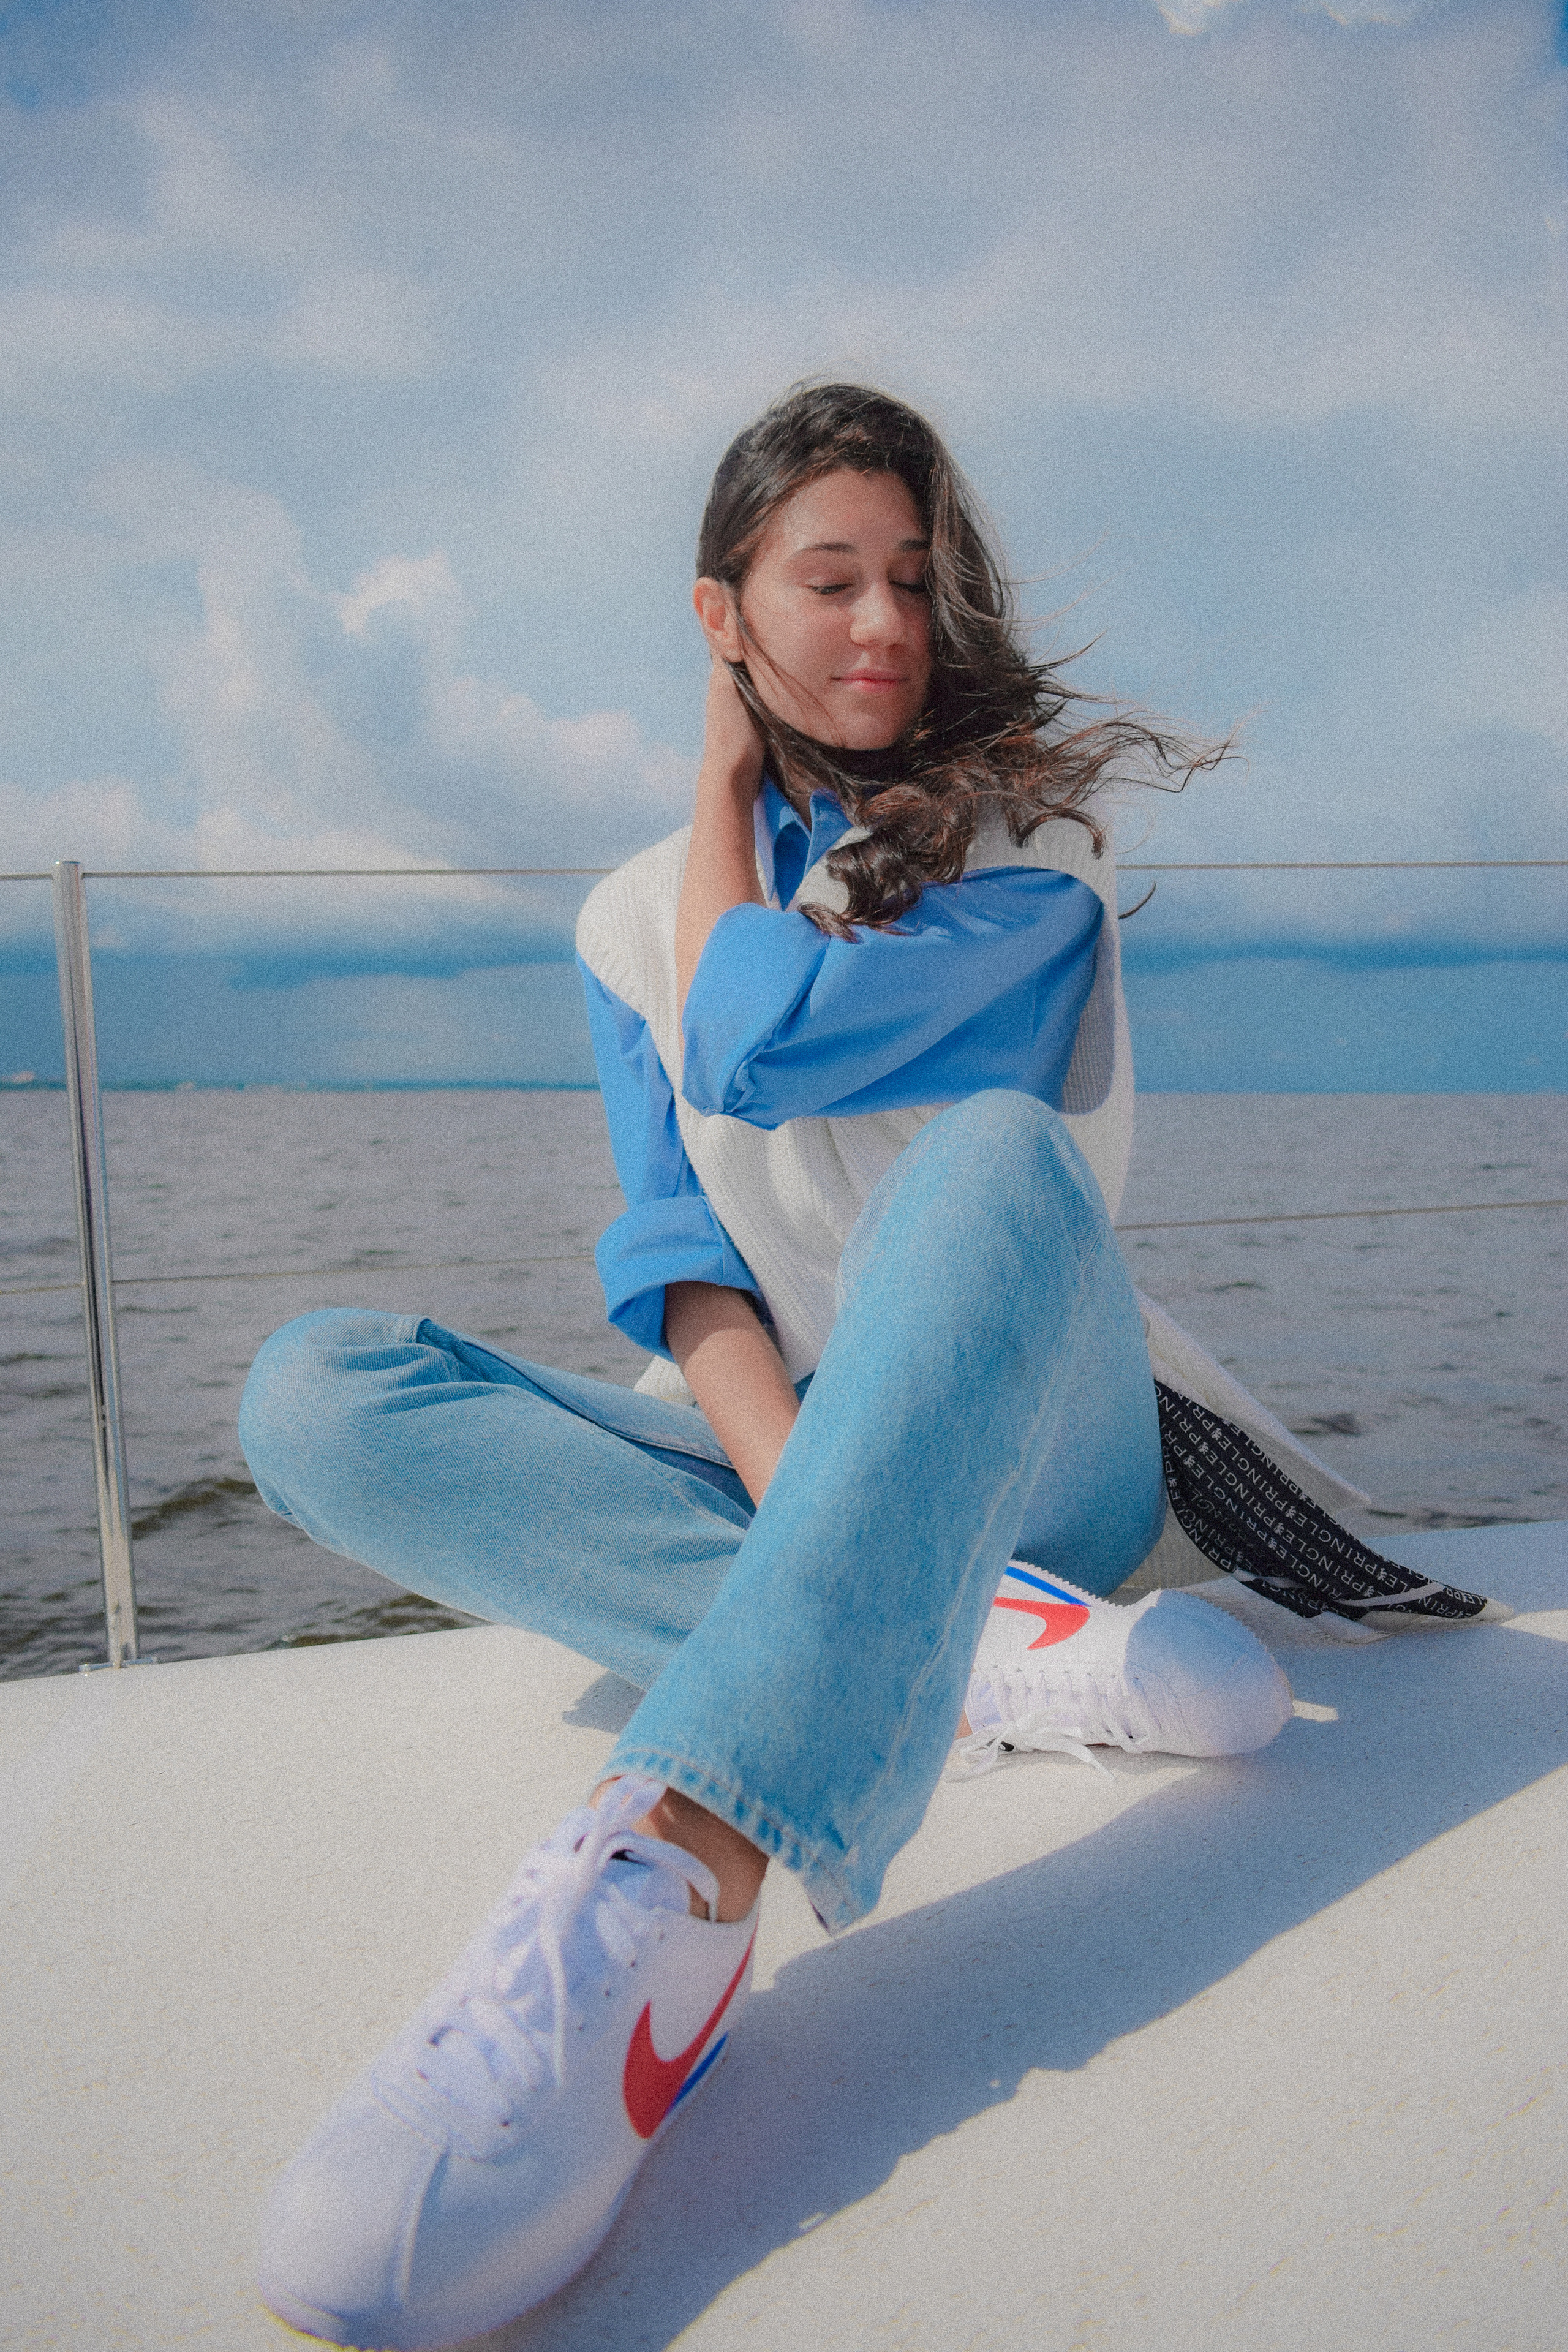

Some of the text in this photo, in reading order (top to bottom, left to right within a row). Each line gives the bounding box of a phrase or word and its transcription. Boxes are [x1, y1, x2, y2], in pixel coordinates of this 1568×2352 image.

[1191, 1463, 1268, 1541] PRINGLE
[1205, 1450, 1276, 1527] PRINGLE
[1218, 1435, 1287, 1510] PRINGLE
[1283, 1529, 1366, 1592] PRINGLE
[1294, 1512, 1378, 1575] PRINGLE
